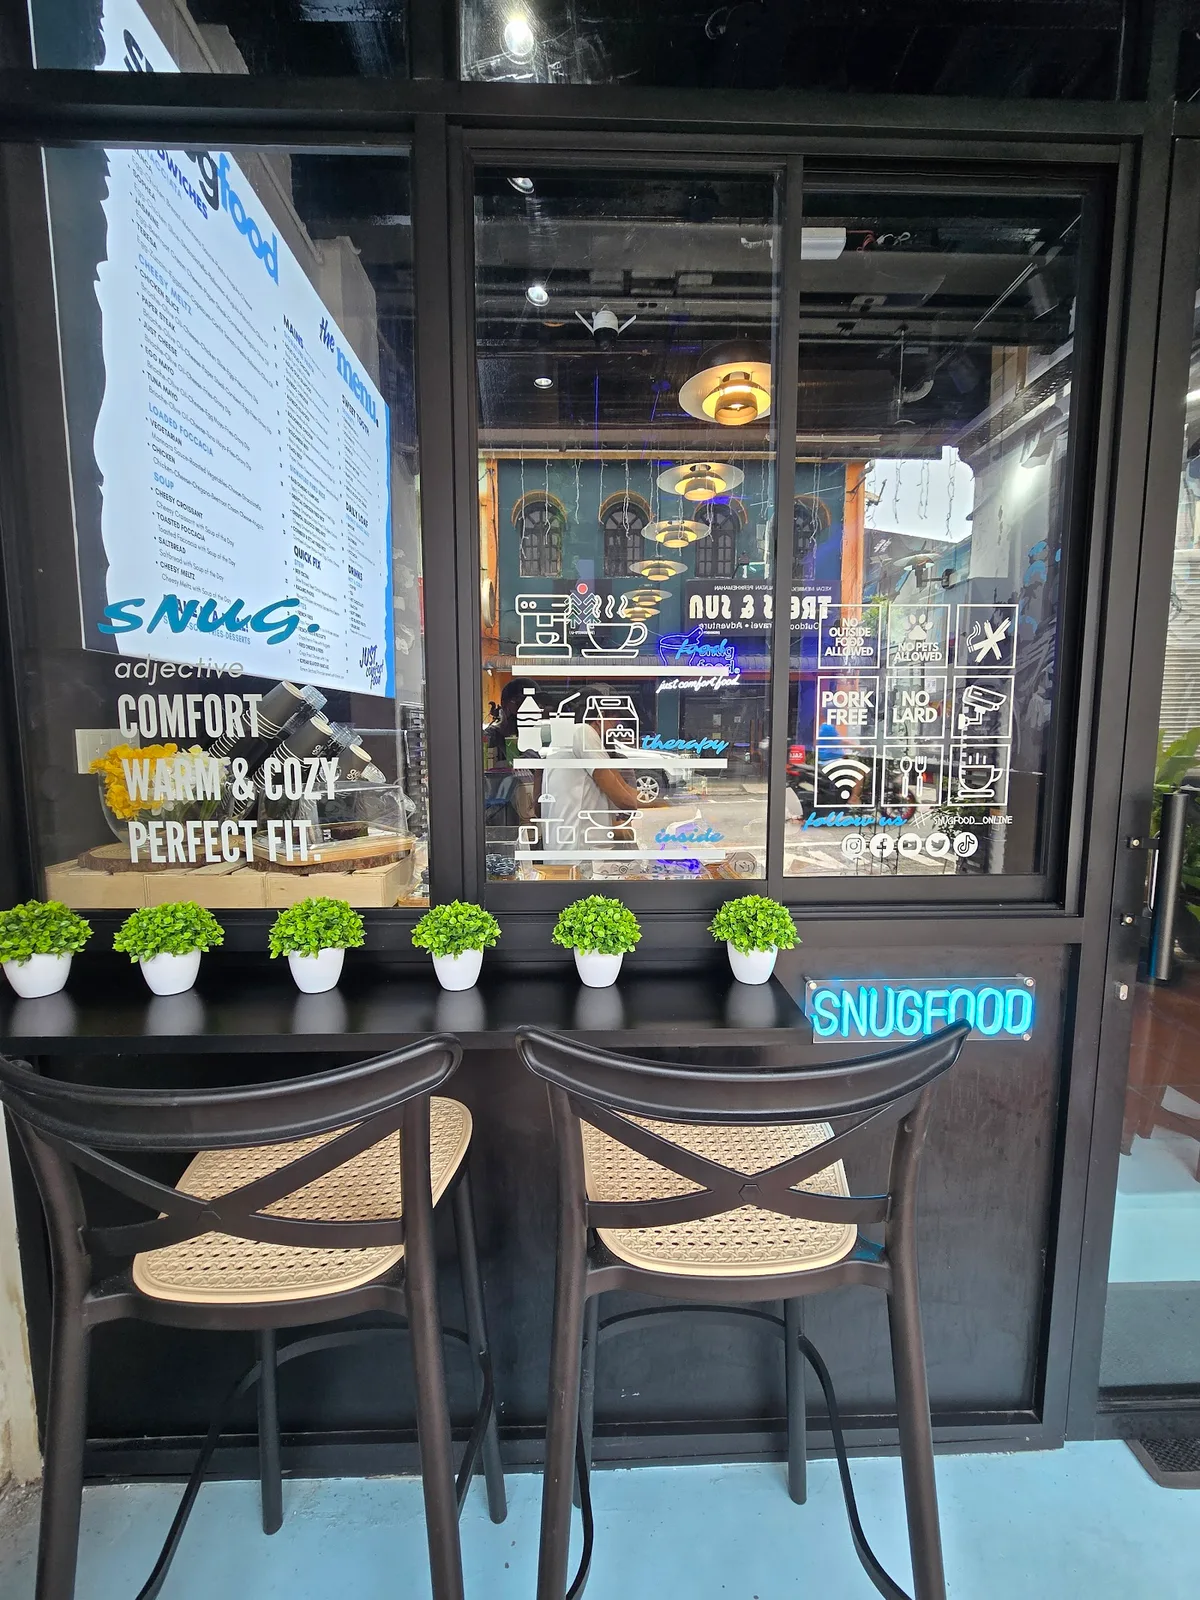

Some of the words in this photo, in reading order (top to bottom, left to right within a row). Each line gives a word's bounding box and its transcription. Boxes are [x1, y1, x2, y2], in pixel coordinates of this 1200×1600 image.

[133, 169, 155, 200] SOPHEA
[134, 196, 159, 228] JASMINE
[136, 223, 156, 249] TERESA
[138, 253, 168, 292] CHEESY
[170, 286, 192, 316] MELTZ
[139, 269, 164, 298] CHICKEN
[165, 294, 179, 313] SLICE
[141, 295, 157, 315] PAPER
[158, 311, 175, 332] STEAK
[143, 321, 156, 338] JUST
[157, 334, 177, 356] CHEESE
[283, 313, 303, 348] MAINS
[319, 316, 335, 354] the
[145, 346, 157, 362] EGG
[158, 357, 174, 376] MAYO
[146, 371, 161, 389] TUNA
[162, 384, 178, 402] MAYO
[148, 402, 177, 431] LOADED
[179, 425, 213, 456] FOCCACIA
[149, 418, 182, 446] VEGETARIAN
[151, 443, 175, 464] CHICKEN
[153, 471, 174, 490] SOUP
[155, 487, 175, 504] CHEESY
[175, 499, 203, 519] CROISSANT
[156, 500, 174, 516] Cheesy
[174, 510, 195, 527] Croissant
[195, 521, 204, 531] with
[205, 526, 215, 537] Soup
[226, 538, 234, 547] Day
[156, 512, 180, 529] TOASTED
[180, 524, 205, 541] FOCCACIA
[157, 524, 176, 539] Toasted
[197, 544, 206, 553] with
[206, 548, 217, 558] Soup
[158, 537, 186, 554] SALTBREAD
[159, 549, 182, 565] Saltbread
[182, 559, 193, 569] with
[193, 563, 203, 573] Soup
[159, 561, 179, 574] CHEESY
[180, 569, 195, 579] MELTZ
[293, 545, 311, 564] QUICK
[312, 556, 321, 569] FIX
[161, 573, 178, 585] Cheesy
[178, 580, 190, 590] Meltz
[191, 584, 201, 593] with
[201, 588, 212, 597] Soup
[223, 596, 231, 604] Day
[828, 627, 872, 638] OUTSIDE
[841, 617, 859, 628] NO
[675, 638, 728, 660] food
[824, 646, 874, 657] ALLOWED
[835, 637, 865, 647] FOOD
[897, 642, 914, 652] NO
[915, 642, 940, 652] PETS
[114, 653, 244, 686] adjective
[359, 644, 378, 669] JUST
[893, 651, 943, 662] ALLOWED
[655, 678, 680, 694] just
[678, 675, 717, 692] comfort
[821, 690, 875, 708] PORK
[901, 690, 930, 707] NO
[117, 693, 263, 739] COMFORT
[826, 708, 868, 726] FREE
[892, 707, 938, 724] LARD
[641, 733, 730, 755] therapy
[122, 757, 222, 802] WARM
[231, 757, 256, 802] &
[263, 756, 339, 801] COZY
[801, 811, 876, 832] follow
[877, 815, 909, 828] us
[129, 819, 258, 864] PERFECT
[267, 819, 321, 863] FIT.
[655, 826, 725, 844] inside
[810, 985, 1033, 1038] SNUGFOOD
